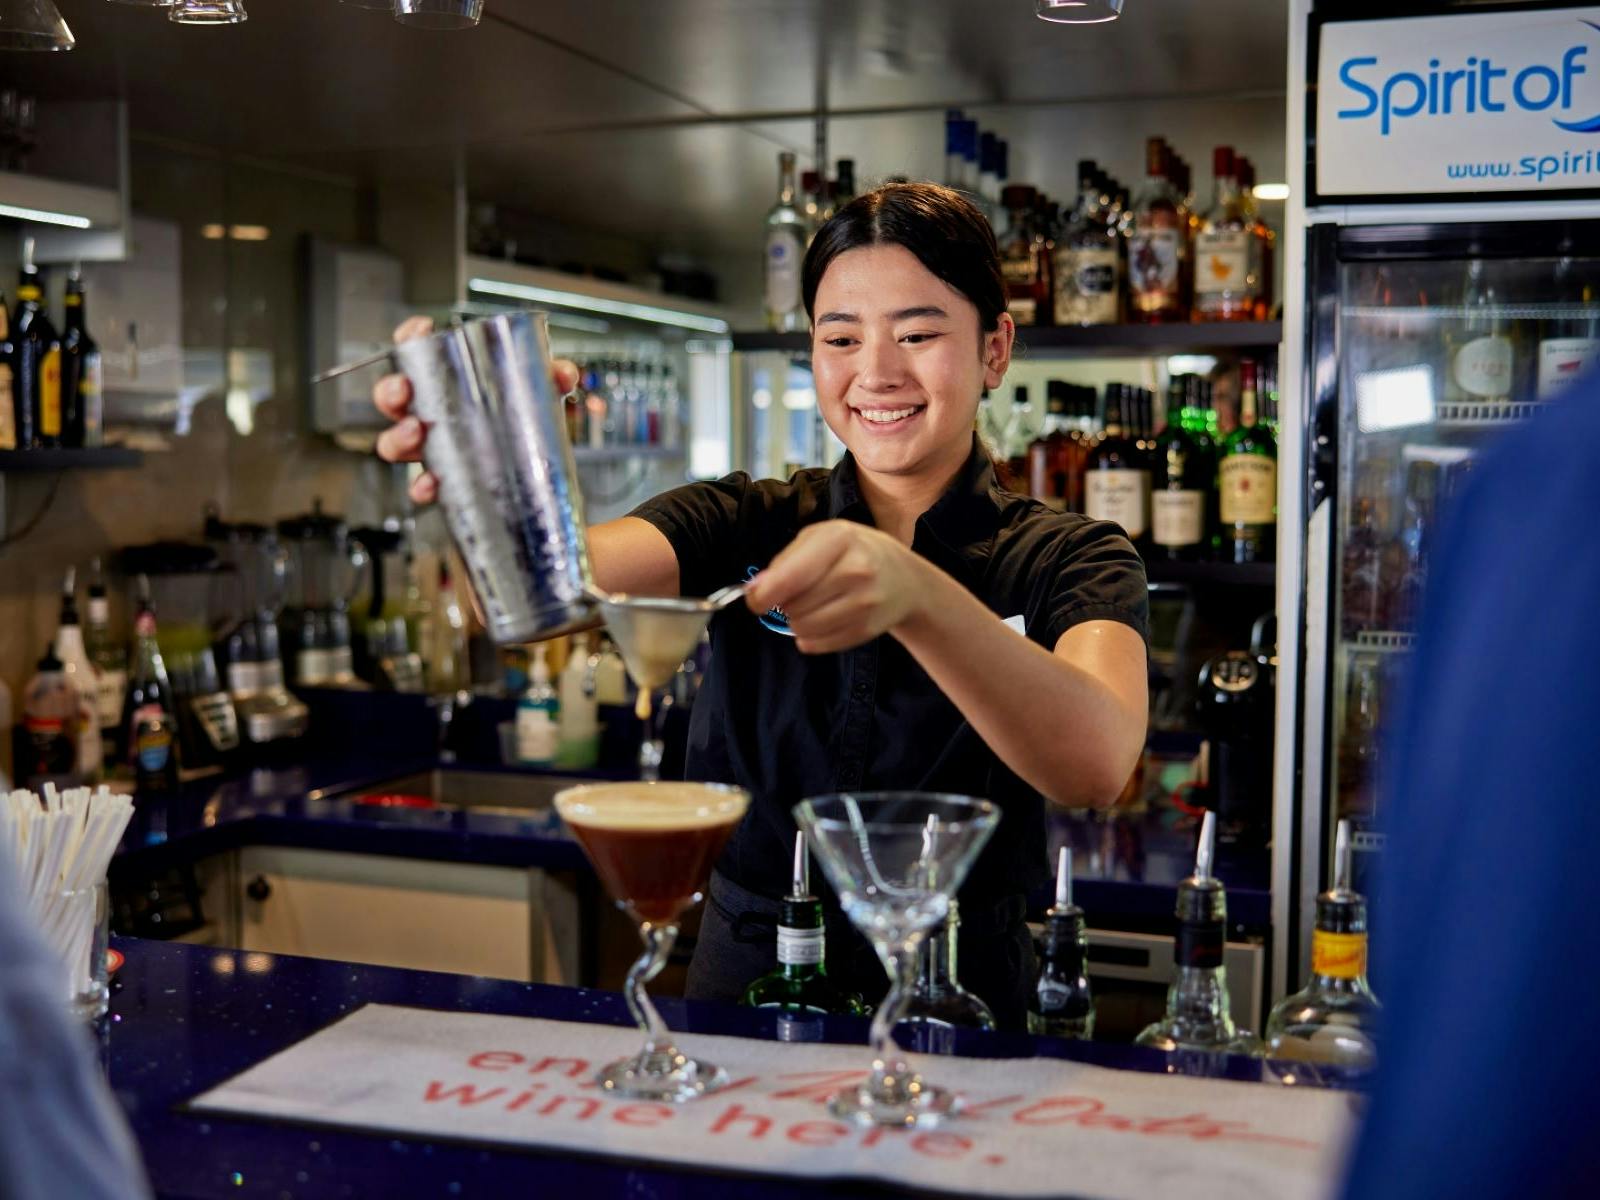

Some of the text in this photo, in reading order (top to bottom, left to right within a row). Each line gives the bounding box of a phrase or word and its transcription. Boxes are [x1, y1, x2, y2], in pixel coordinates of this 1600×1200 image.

[1338, 45, 1588, 136] Spirit of
[424, 1080, 1004, 1165] wine here.
